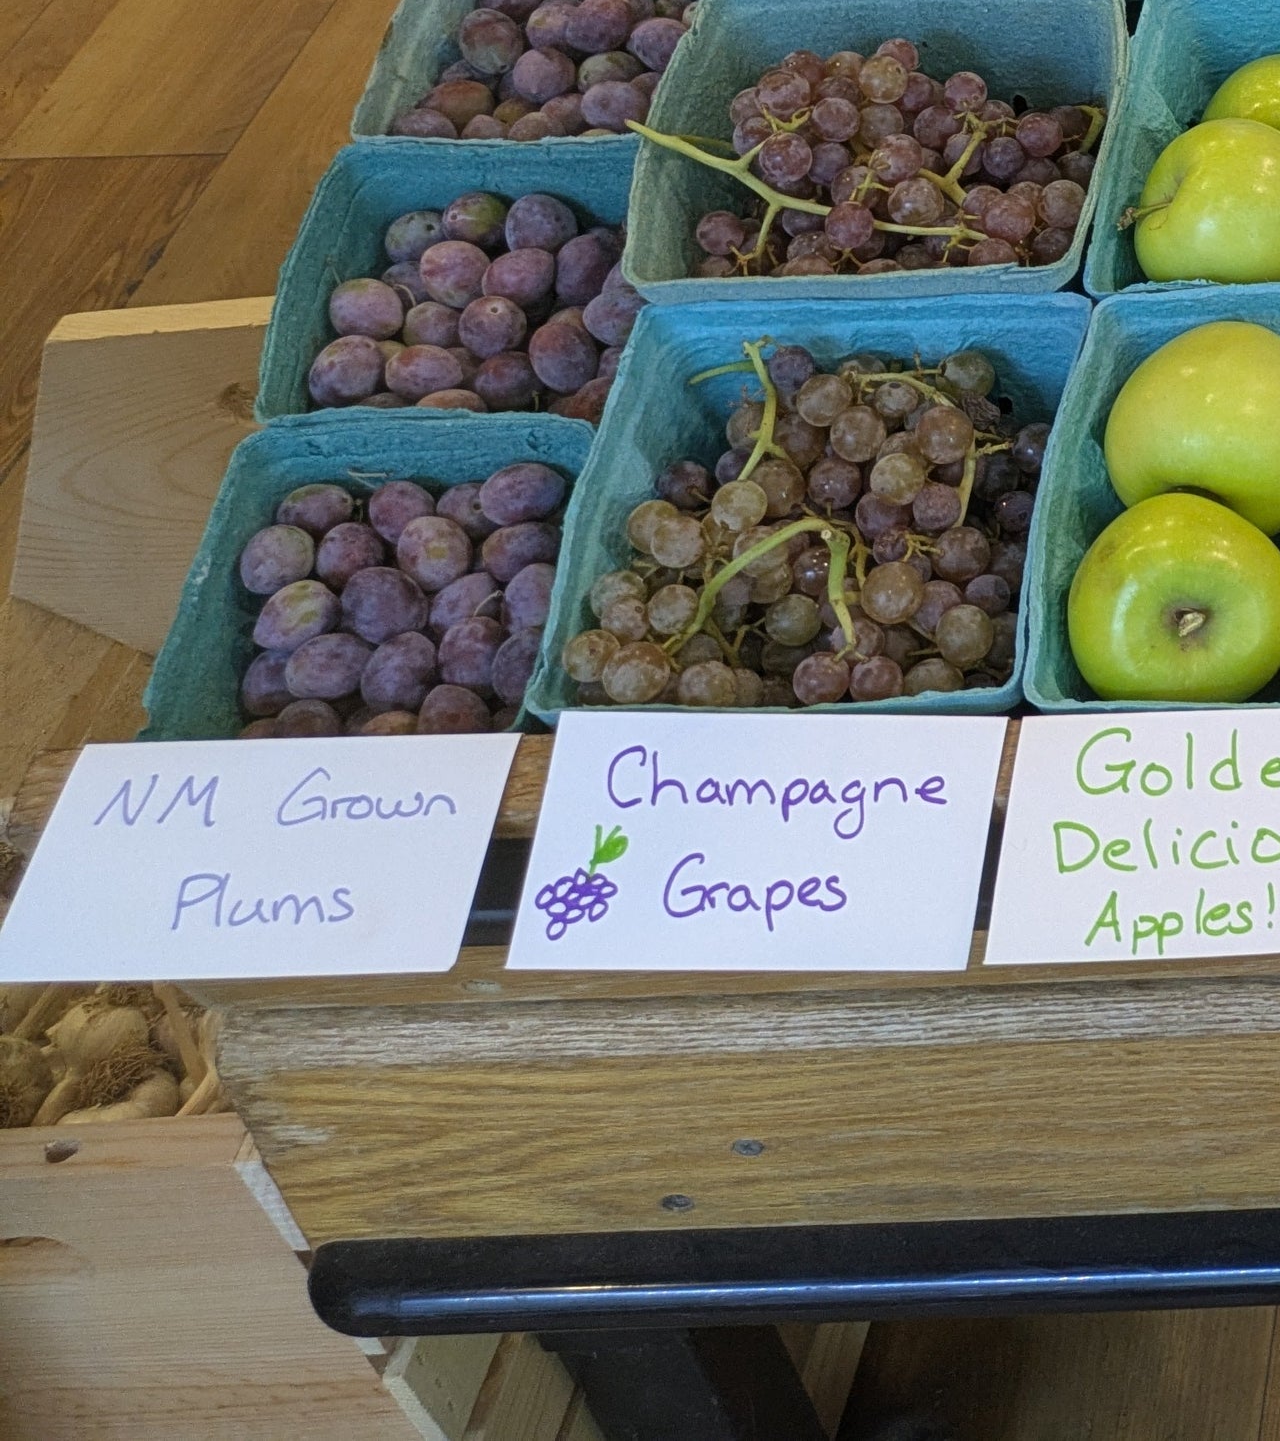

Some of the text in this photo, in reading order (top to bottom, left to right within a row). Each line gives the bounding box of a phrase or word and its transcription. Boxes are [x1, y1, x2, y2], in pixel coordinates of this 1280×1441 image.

[93, 766, 459, 827] NM Grown
[606, 744, 948, 840] Champagne
[170, 871, 356, 932] Plums
[662, 852, 849, 933] Grapes
[1084, 881, 1276, 956] Apples!
